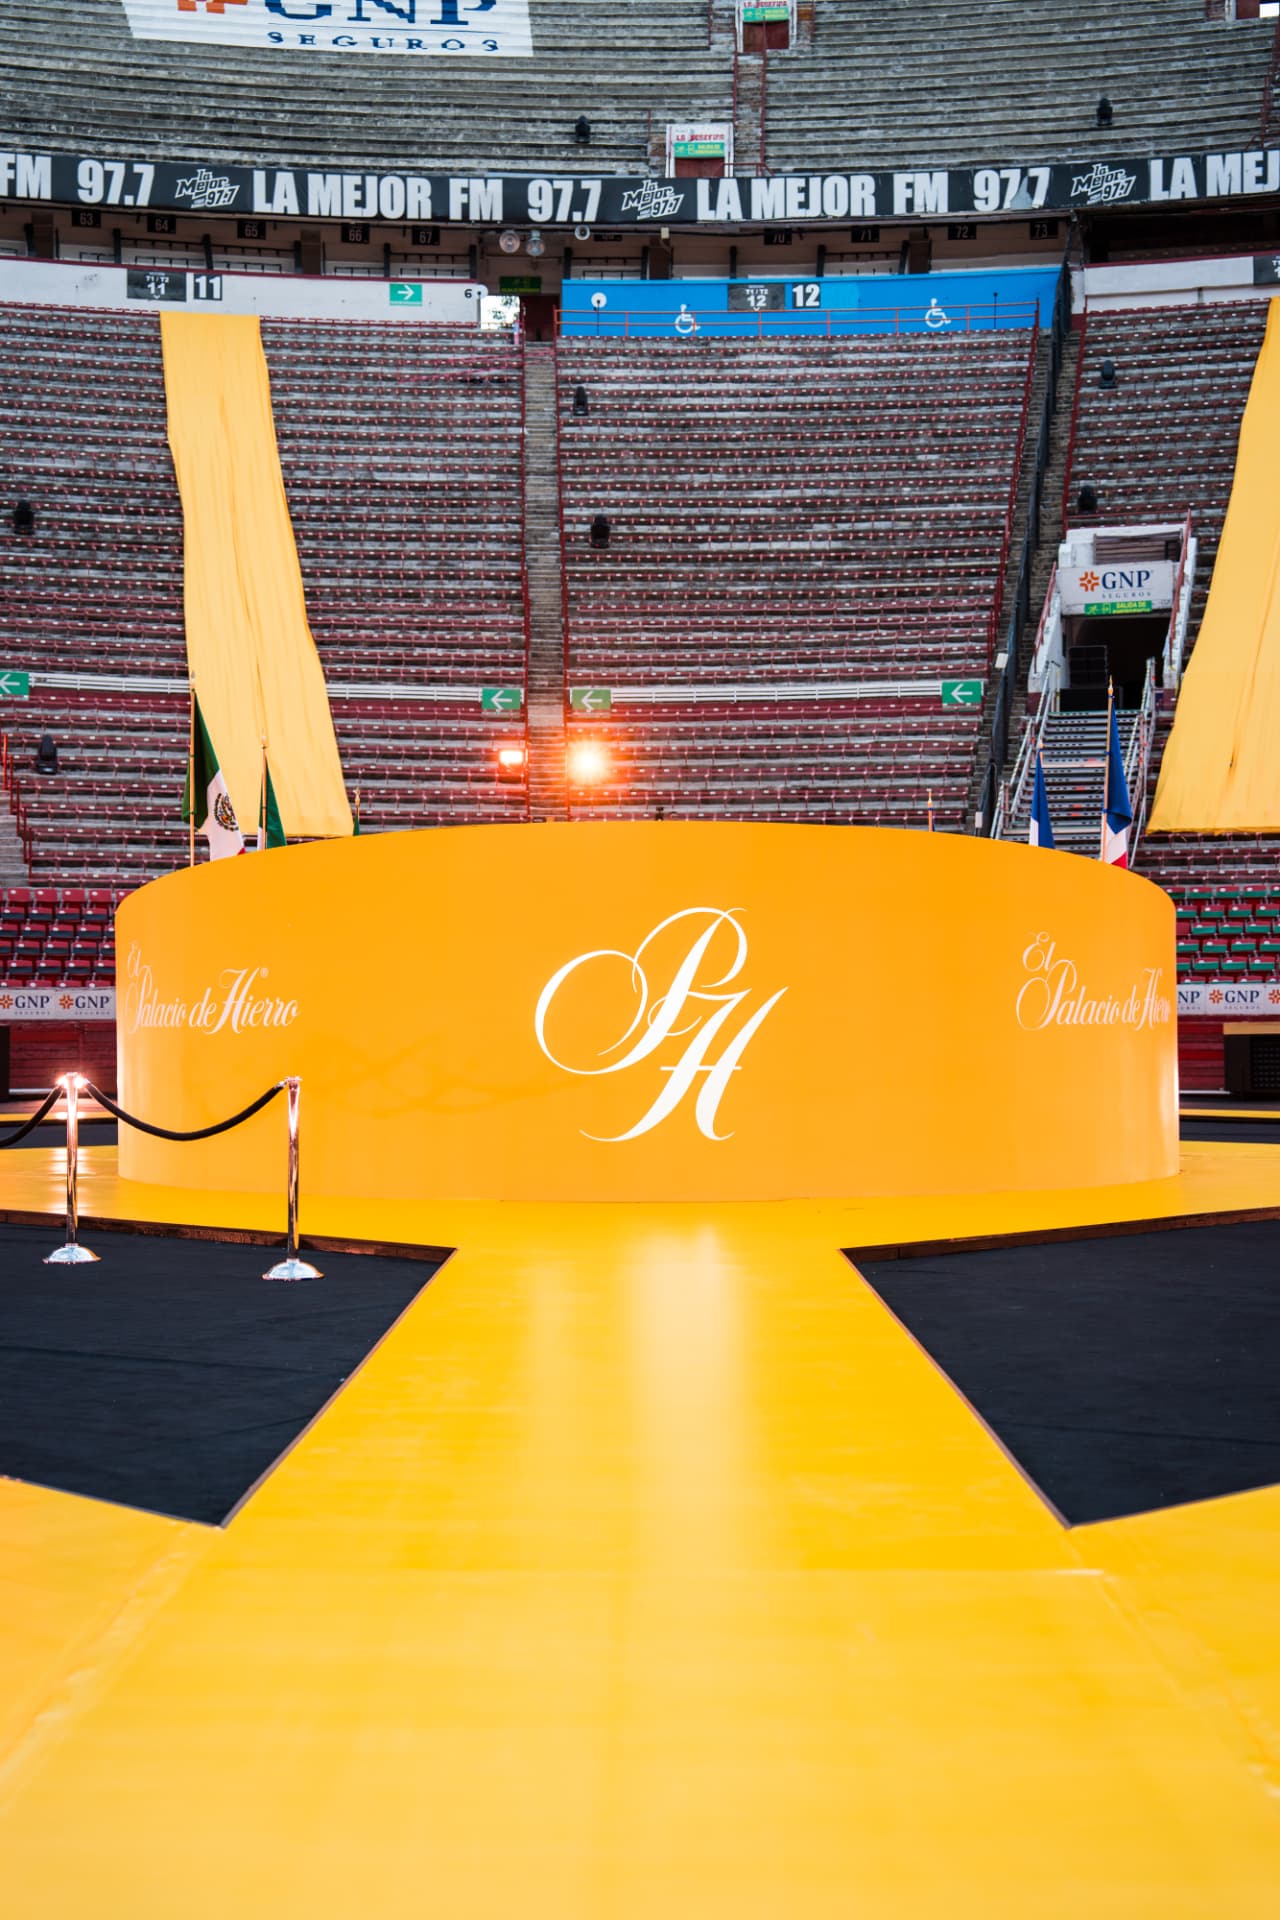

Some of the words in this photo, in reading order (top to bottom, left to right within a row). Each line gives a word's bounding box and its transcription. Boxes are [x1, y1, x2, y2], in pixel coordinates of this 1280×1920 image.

[265, 31, 499, 52] SEGUROS
[0, 153, 52, 200] FM
[77, 159, 155, 207] 97.7
[1070, 169, 1126, 197] Mejor
[1150, 157, 1199, 200] LA
[1206, 149, 1280, 197] MEJ
[175, 177, 229, 199] Mejor
[253, 169, 299, 215] LA
[307, 173, 432, 220] MEJOR
[449, 177, 503, 221] FM
[527, 179, 602, 223] 97.7
[621, 186, 674, 211] Mejor
[697, 178, 743, 221] LA
[751, 174, 876, 220] MEJOR
[893, 171, 949, 215] FM
[973, 166, 1051, 212] 977
[147, 282, 165, 295] 11
[195, 275, 221, 299] 11
[464, 289, 473, 298] 6
[792, 283, 821, 308] 12
[747, 295, 767, 307] 12
[1102, 570, 1150, 590] GNP
[1022, 931, 1056, 973] El
[15, 995, 50, 1009] GNP
[75, 995, 110, 1009] GNP
[126, 965, 187, 1035] Palacio
[188, 987, 218, 1028] de
[1015, 959, 1121, 1031] Palacio
[1121, 985, 1141, 1023] de
[1178, 990, 1200, 1004] NP
[1225, 990, 1260, 1004] GNP
